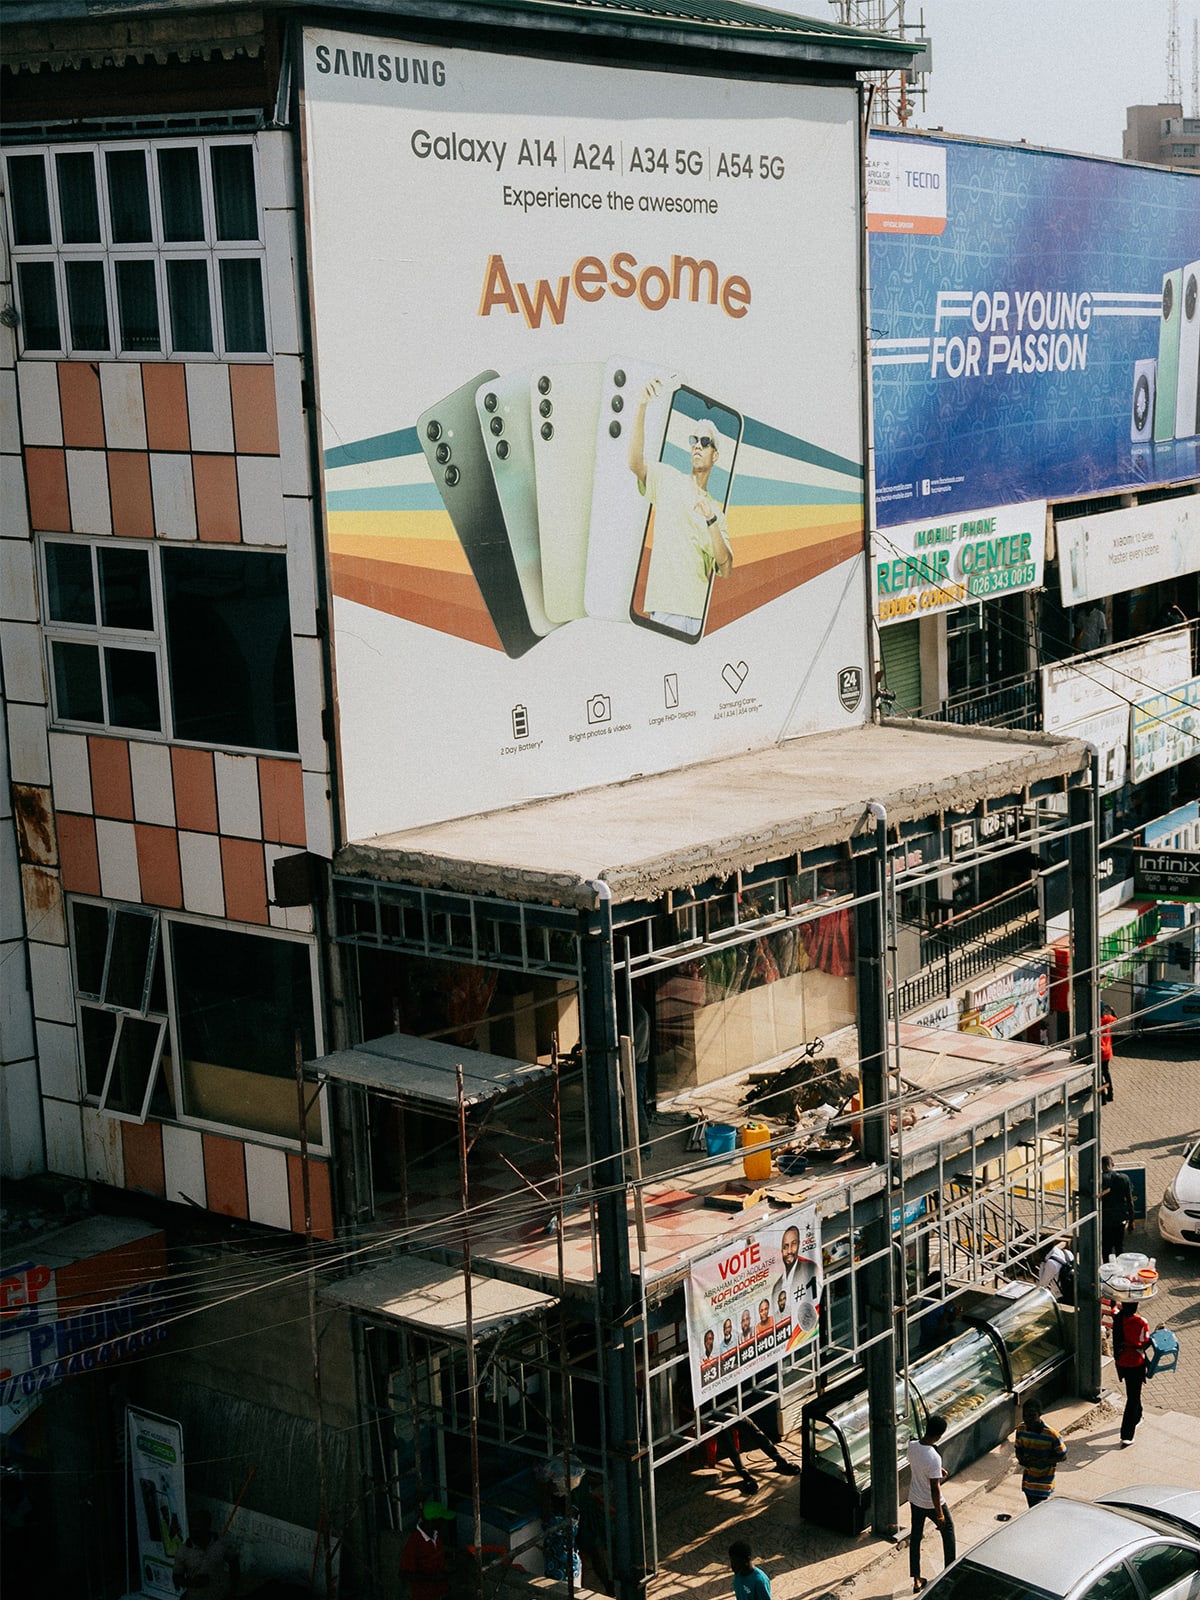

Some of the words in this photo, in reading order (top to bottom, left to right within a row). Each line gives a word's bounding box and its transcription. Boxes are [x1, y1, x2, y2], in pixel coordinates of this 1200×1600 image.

[316, 44, 446, 87] SAMSUNG
[411, 129, 506, 171] Galaxy
[517, 138, 558, 168] A14
[573, 143, 615, 171] A24
[630, 147, 669, 173] A34
[675, 150, 703, 176] 5G
[717, 151, 754, 178] A54
[759, 154, 785, 180] 5G
[905, 170, 940, 190] TECNO
[503, 186, 602, 213] Experience
[607, 191, 634, 211] the
[638, 194, 719, 214] awesome
[935, 291, 1008, 332] FOR
[1013, 292, 1093, 331] YOUNG
[931, 336, 981, 378] FOR
[987, 334, 1089, 376] PASSION
[916, 525, 957, 547] MOBILE
[960, 517, 997, 538] PHONE
[1112, 535, 1134, 548] xiaomi
[877, 549, 950, 595] REPAIR
[961, 532, 1032, 574] CENTER
[1108, 552, 1128, 564] Master
[972, 576, 990, 594] 026
[992, 572, 1009, 591] 343
[1011, 568, 1034, 587] 0015
[879, 594, 918, 619] EDDIES
[920, 583, 965, 609] CORNER
[843, 671, 858, 688] 24
[648, 717, 663, 727] Large
[678, 710, 697, 722] Display
[568, 731, 584, 743] Bright
[585, 728, 606, 742] photos
[613, 723, 632, 734] videos
[499, 747, 505, 756] 2
[506, 745, 518, 756] Day
[1139, 856, 1200, 873] Infinix
[718, 1242, 761, 1280] VOTE
[704, 1280, 733, 1298] ABRAHAM
[711, 1290, 732, 1306] KOFI
[794, 1275, 818, 1303] #1
[776, 1324, 792, 1342] #11
[741, 1345, 755, 1362] #8
[757, 1335, 775, 1353] #10
[723, 1355, 736, 1371] #7
[703, 1367, 717, 1383] #3
